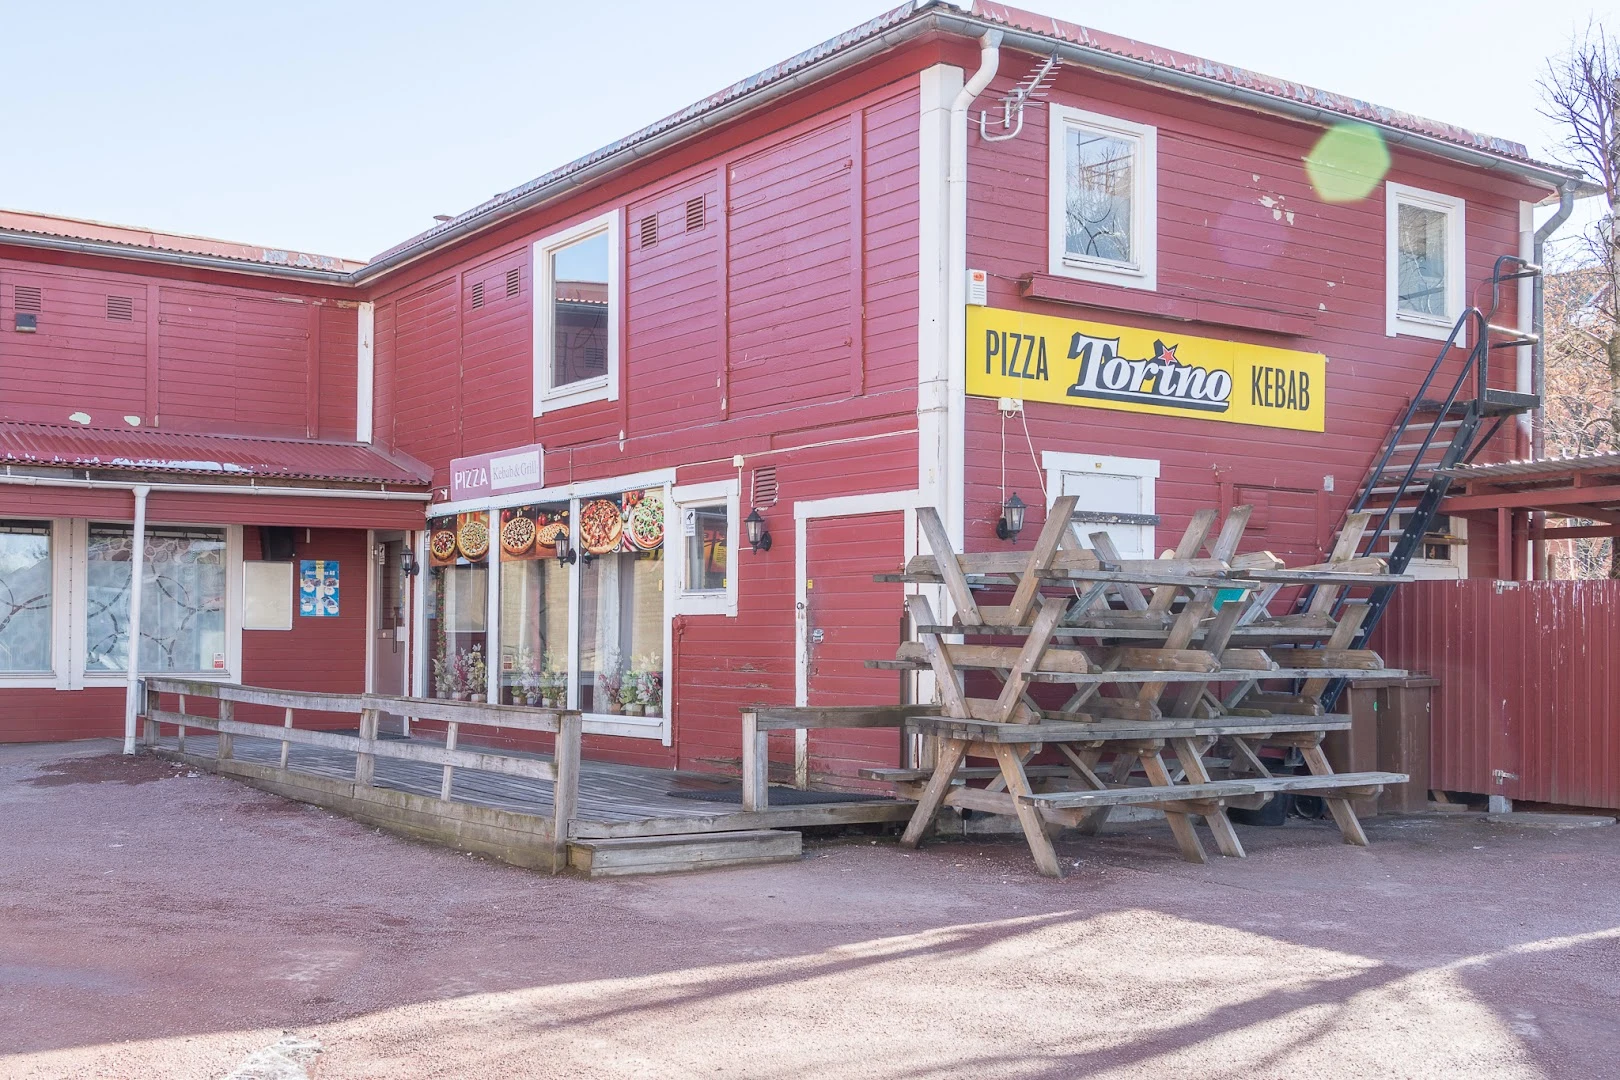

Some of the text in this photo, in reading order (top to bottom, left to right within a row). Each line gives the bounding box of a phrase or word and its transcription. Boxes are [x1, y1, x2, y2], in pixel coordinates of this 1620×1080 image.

[986, 329, 1310, 411] PIZZA Torino KEBAB
[455, 467, 488, 490] PIZZA
[492, 460, 537, 480] Kebab & Grill
